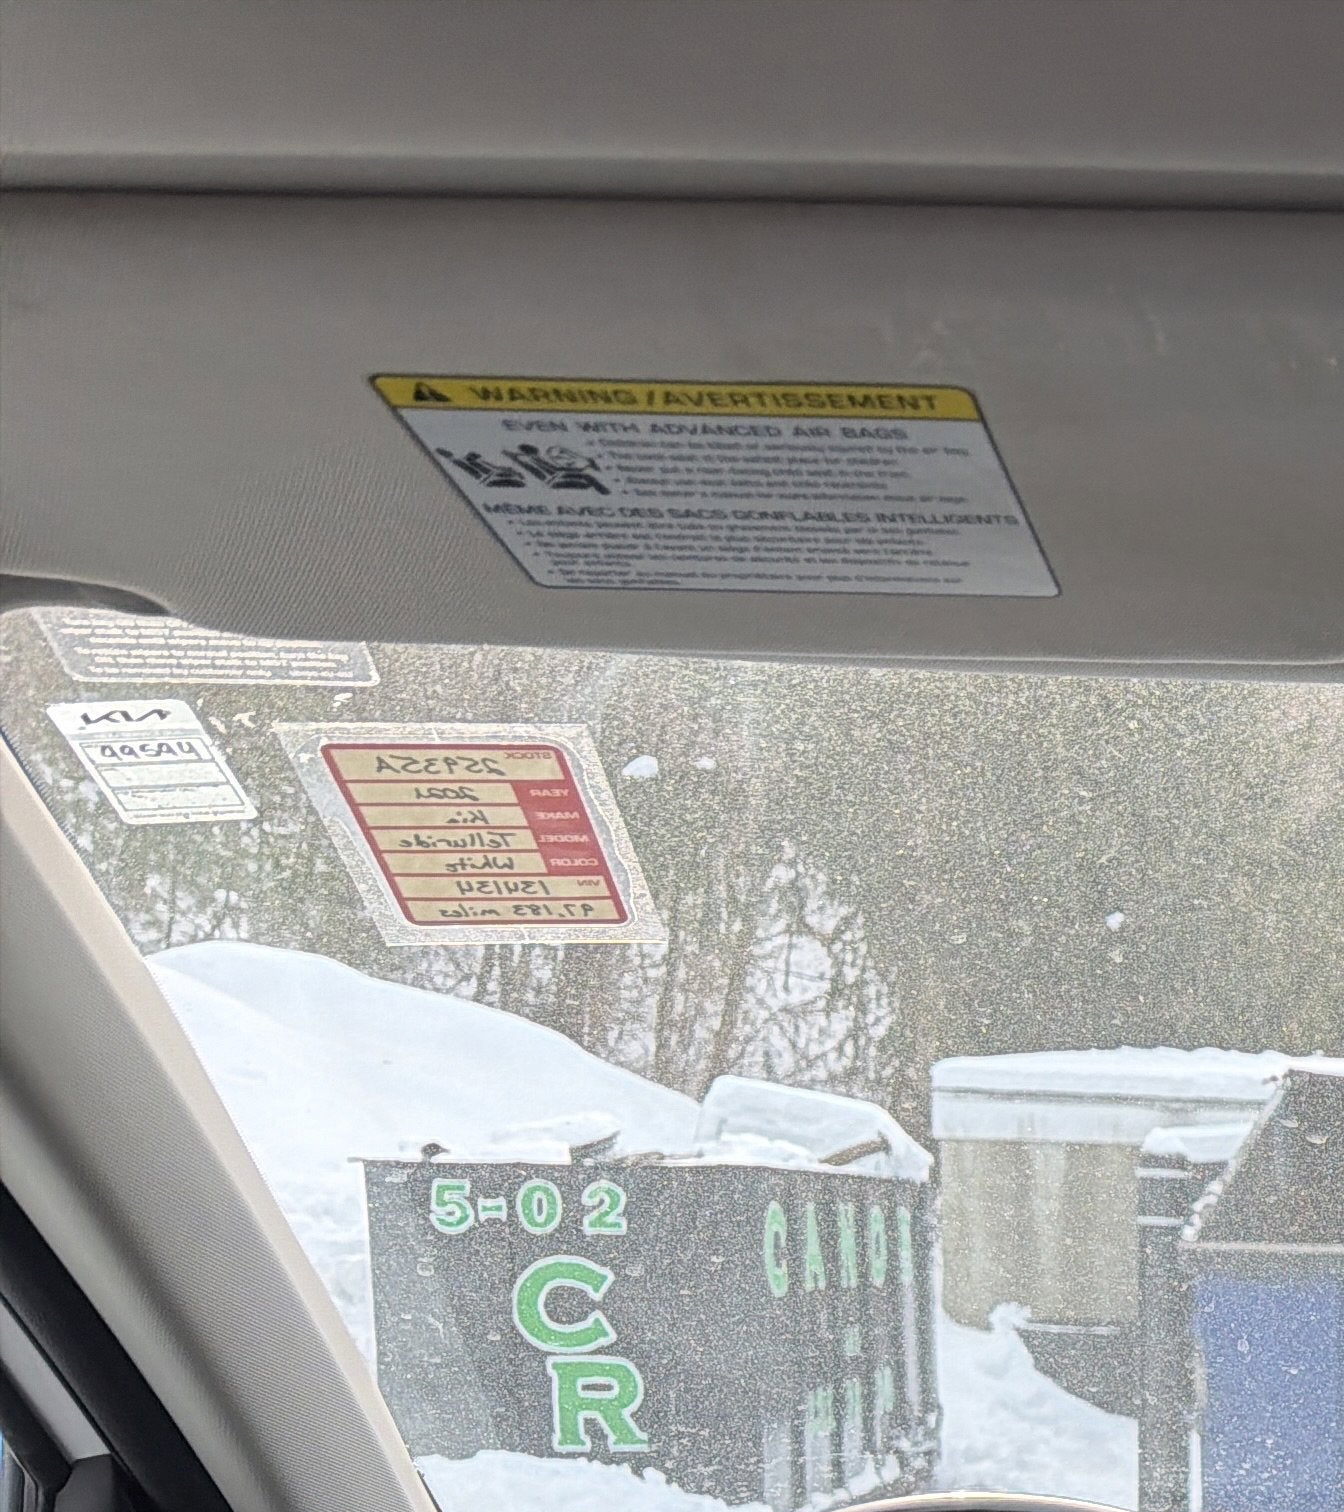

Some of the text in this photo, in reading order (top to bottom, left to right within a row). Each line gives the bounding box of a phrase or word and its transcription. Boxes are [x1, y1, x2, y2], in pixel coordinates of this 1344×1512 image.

[470, 384, 636, 406] WARNING
[663, 388, 938, 411] AVERTISSEMENT
[502, 419, 909, 441] EVEN WITH ADVANCED AIR BAGS
[513, 1255, 617, 1354] C
[547, 1355, 650, 1453] R
